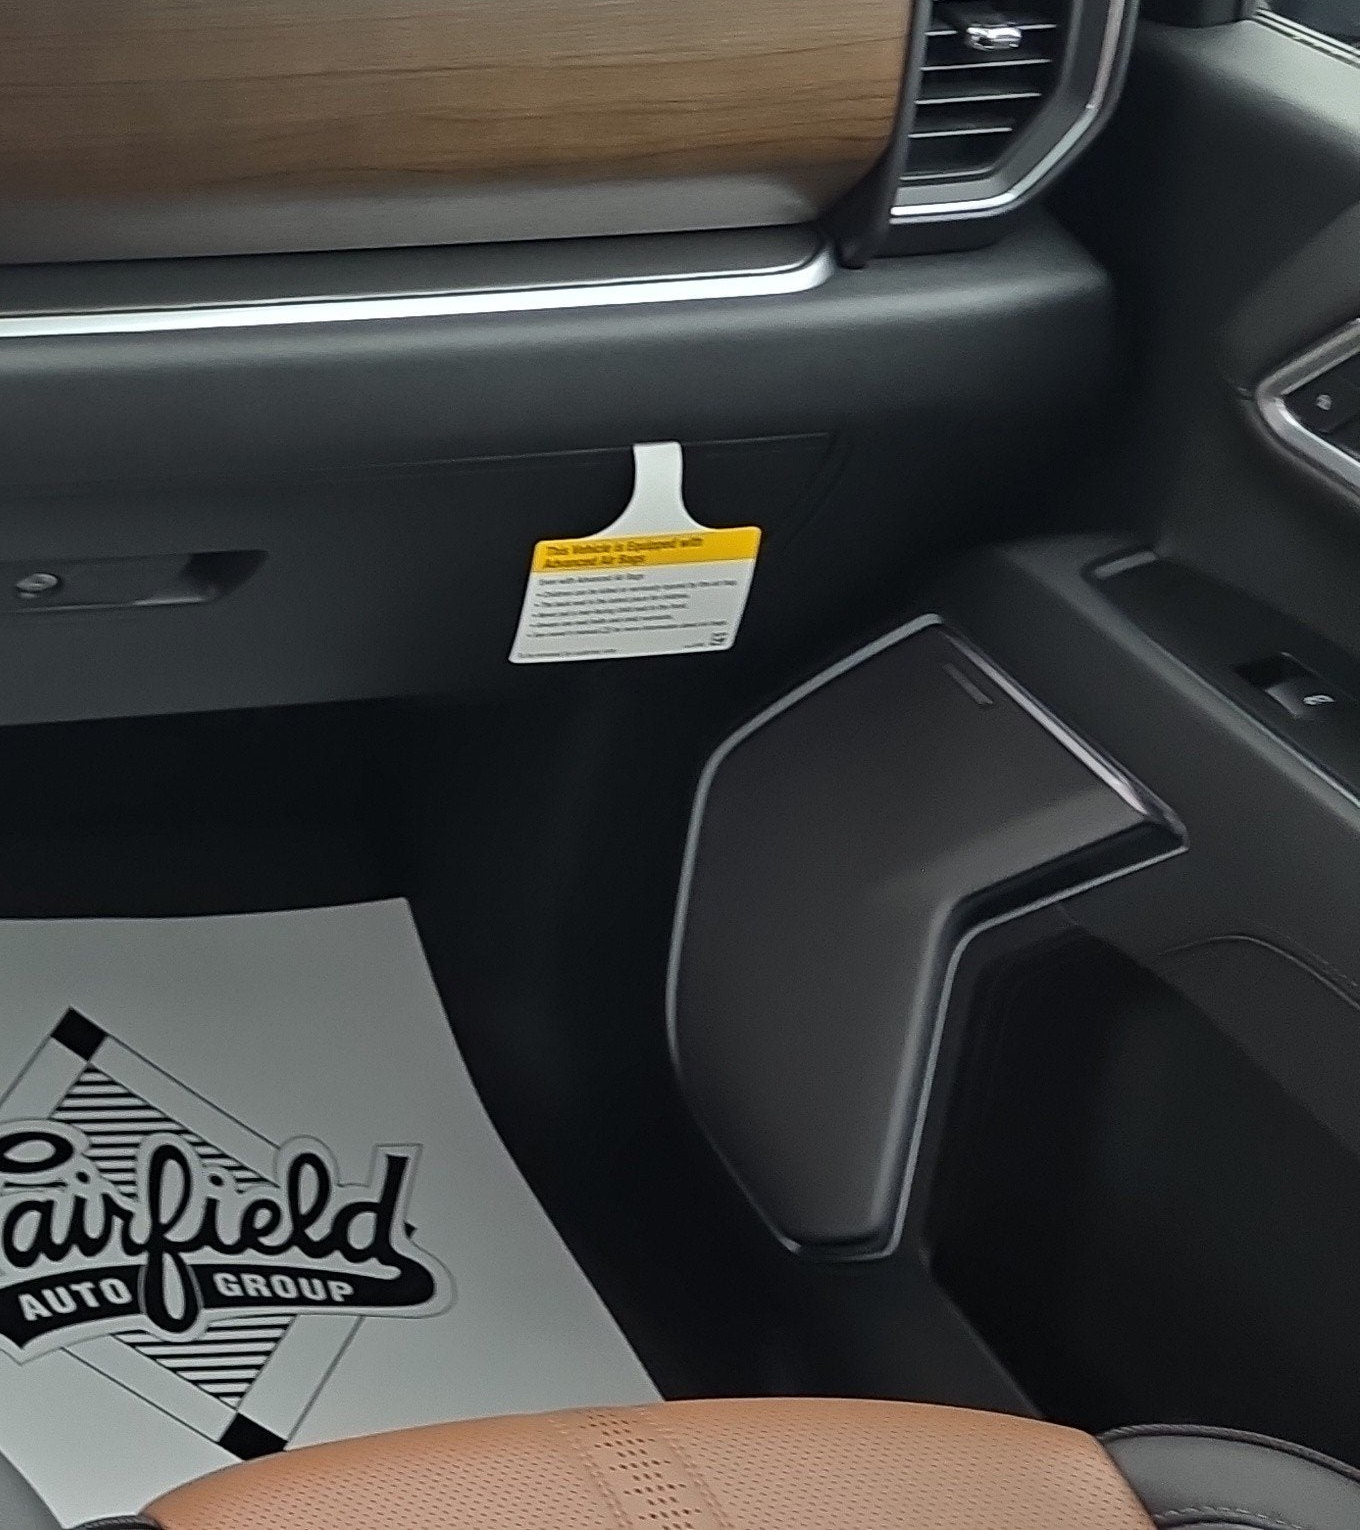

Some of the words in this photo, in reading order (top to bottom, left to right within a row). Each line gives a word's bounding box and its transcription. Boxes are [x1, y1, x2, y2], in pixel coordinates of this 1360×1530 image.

[546, 545, 569, 555] This
[572, 544, 611, 554] Vehicle
[626, 539, 677, 551] Equipped
[18, 1278, 132, 1321] AUTO
[212, 1273, 355, 1302] GROUP
